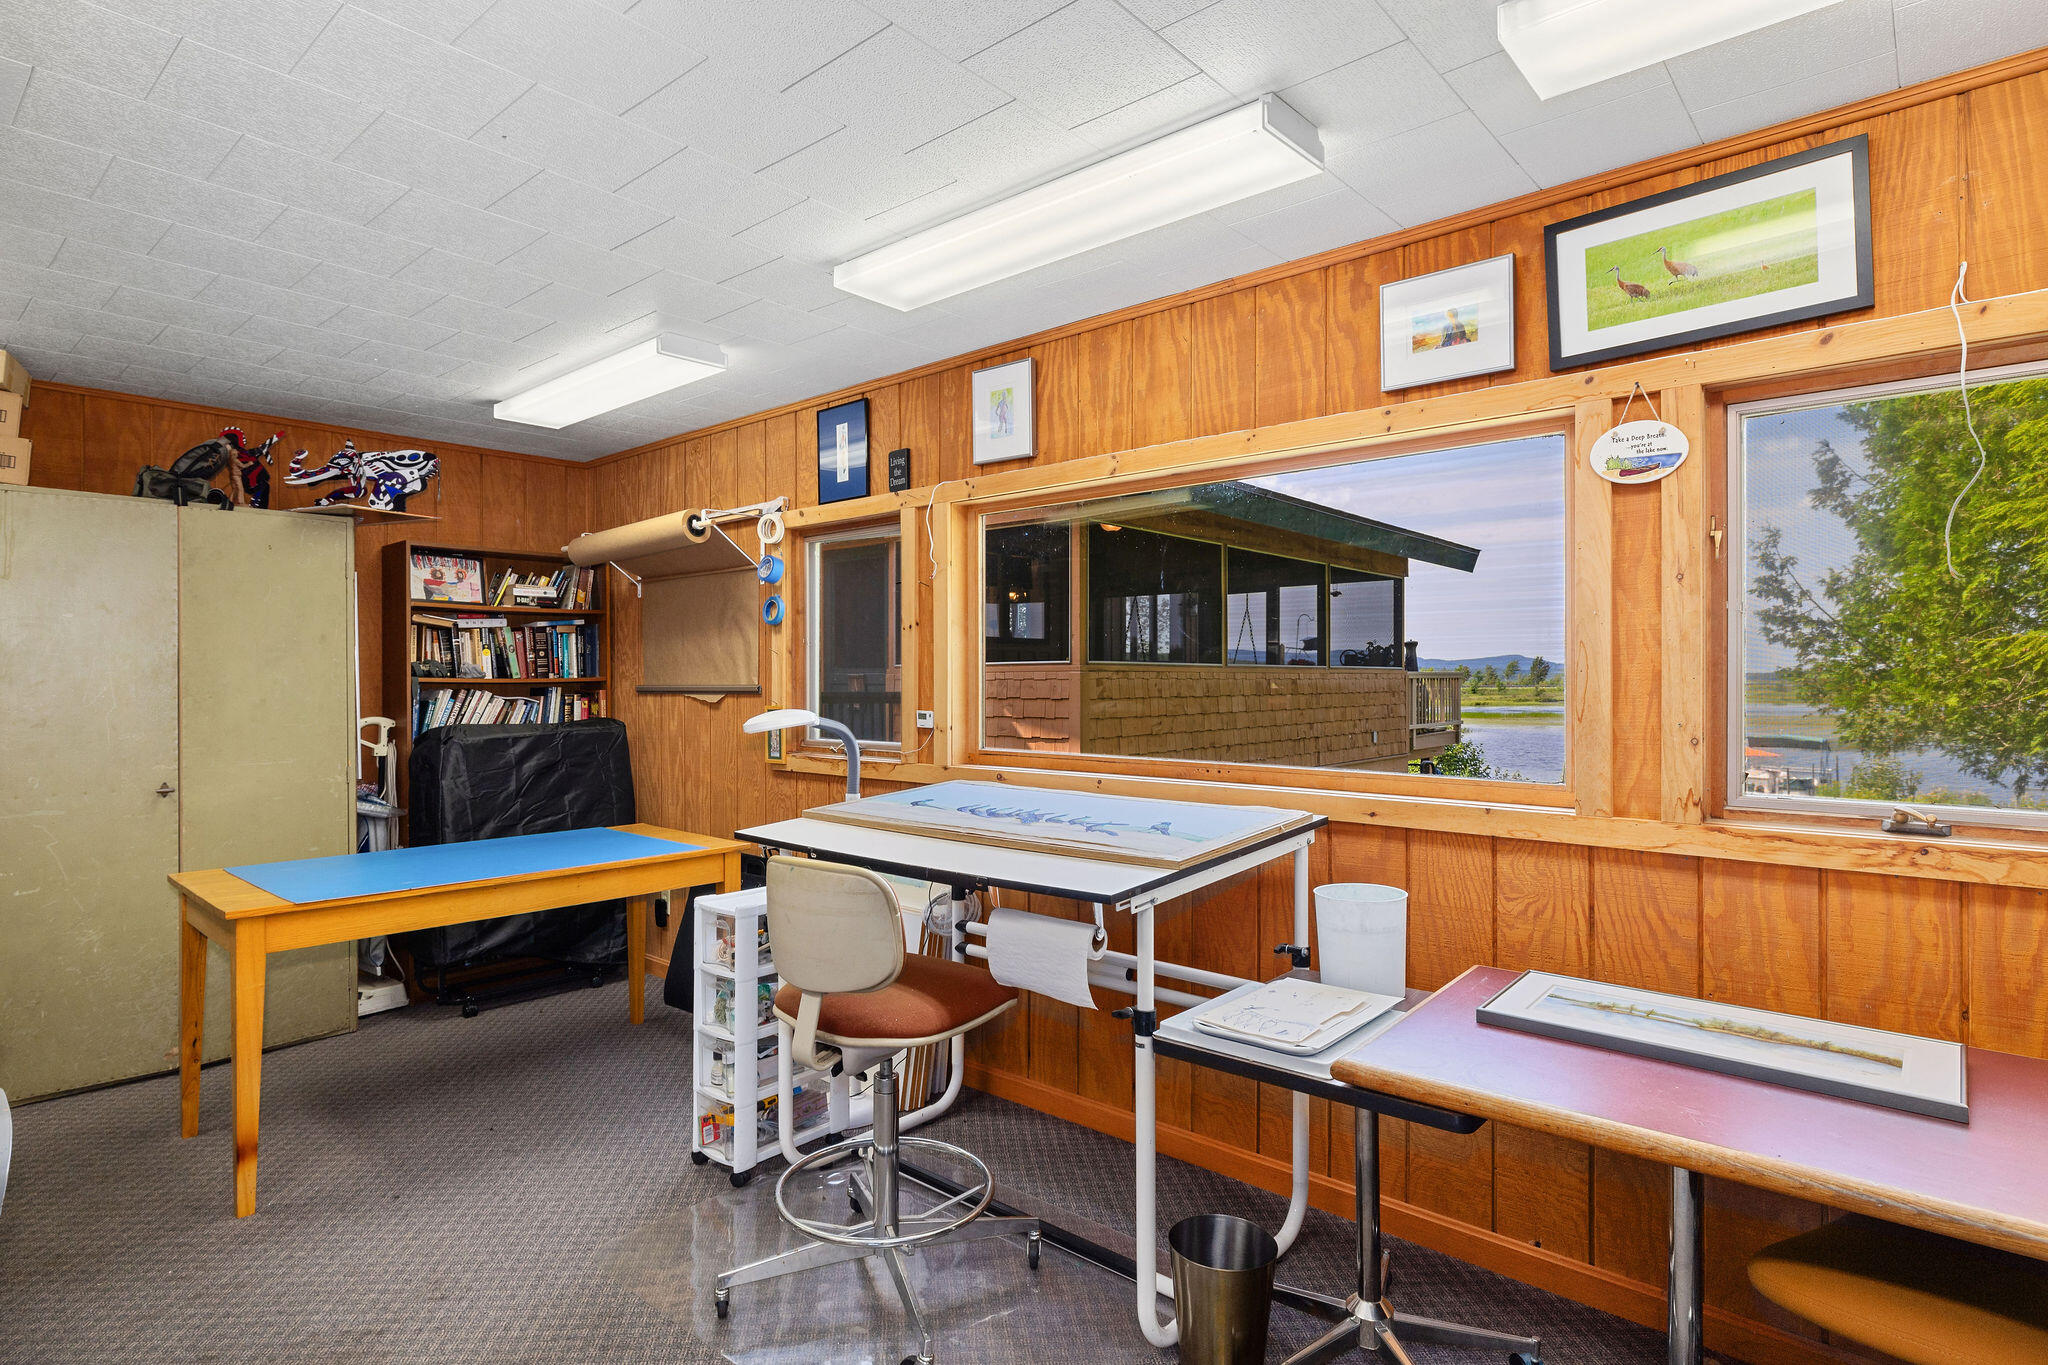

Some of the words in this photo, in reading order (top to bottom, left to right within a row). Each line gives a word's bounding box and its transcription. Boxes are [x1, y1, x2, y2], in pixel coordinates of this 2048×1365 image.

[891, 457, 905, 466] Living
[894, 468, 902, 477] the
[890, 478, 905, 487] Dream
